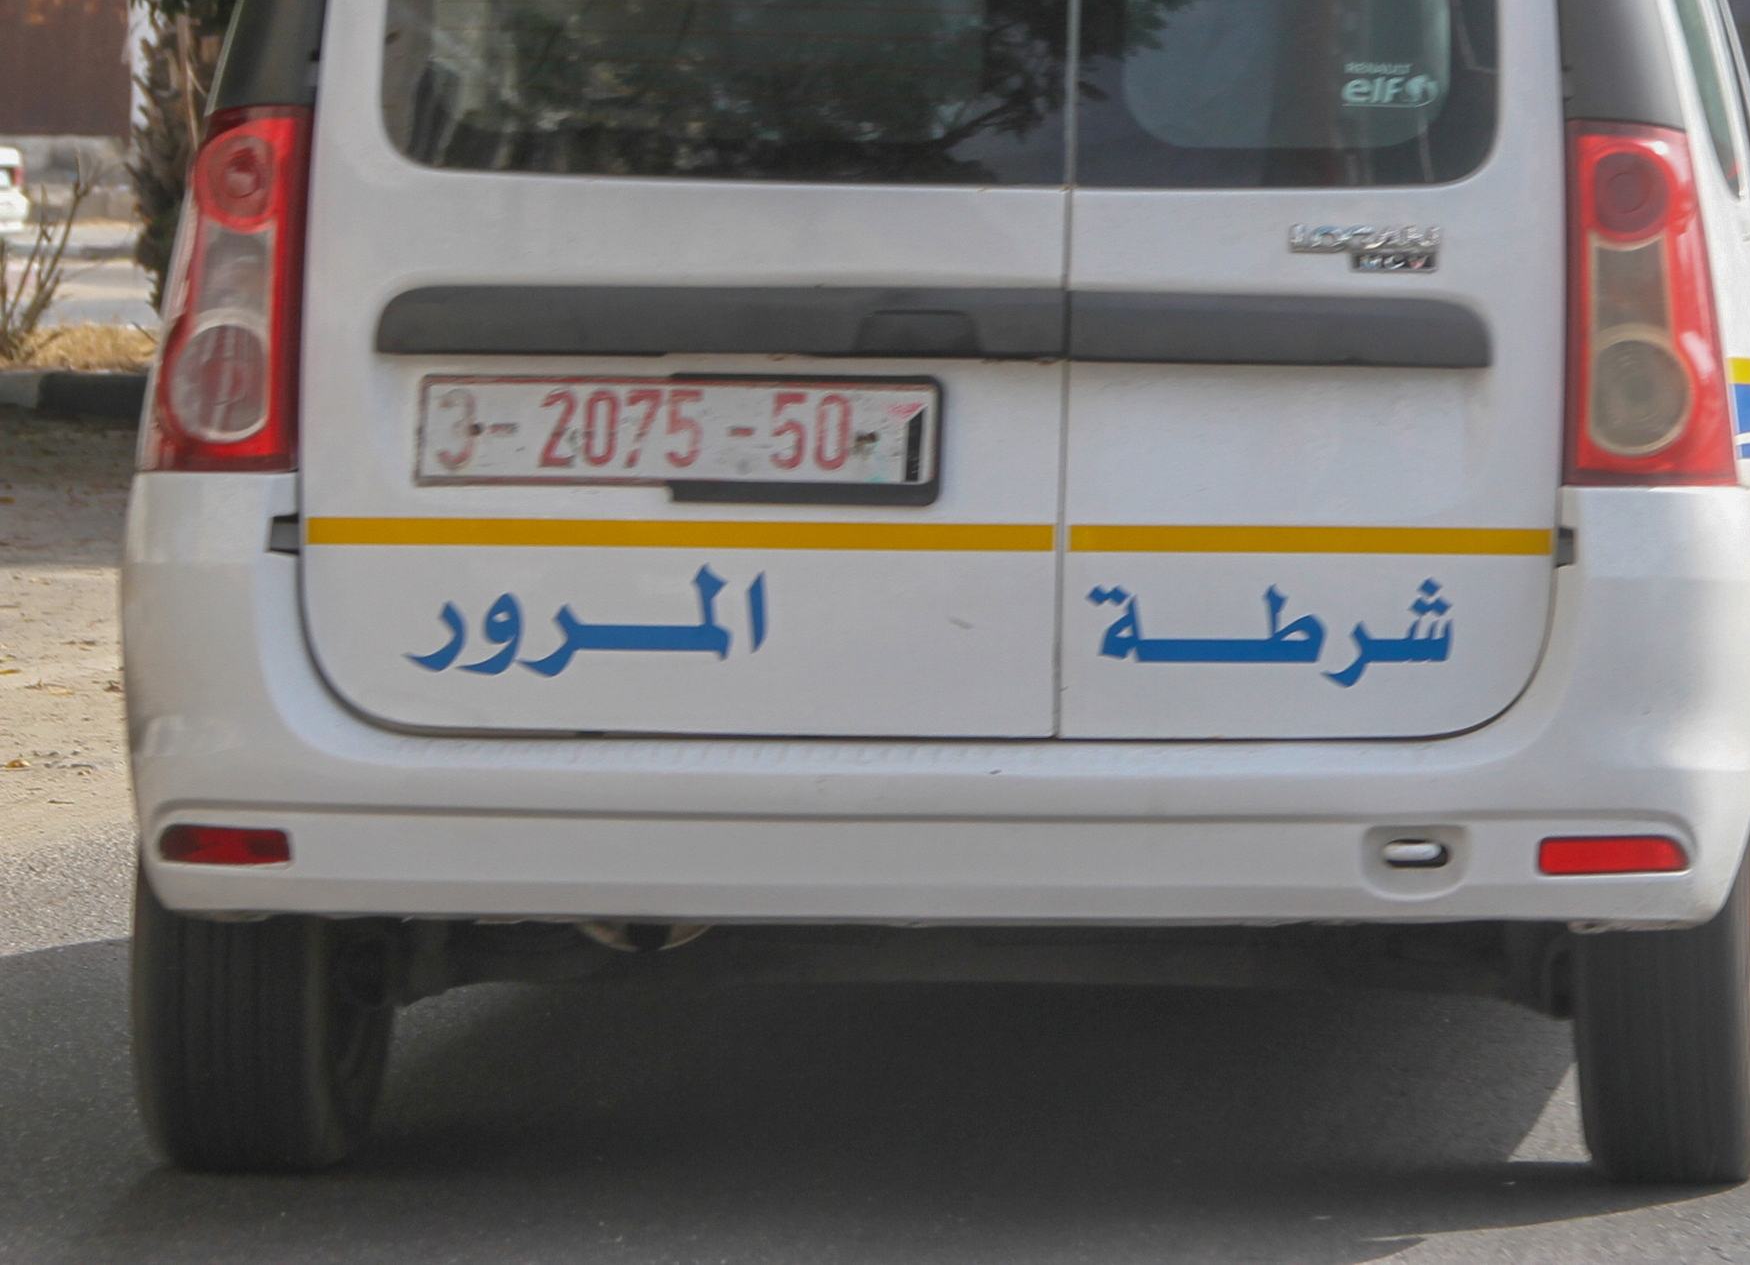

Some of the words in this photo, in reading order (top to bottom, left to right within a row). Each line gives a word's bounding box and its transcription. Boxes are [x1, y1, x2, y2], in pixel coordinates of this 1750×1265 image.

[1341, 76, 1405, 103] elf
[404, 562, 767, 677] المرور
[1086, 577, 1453, 687] شرطة
